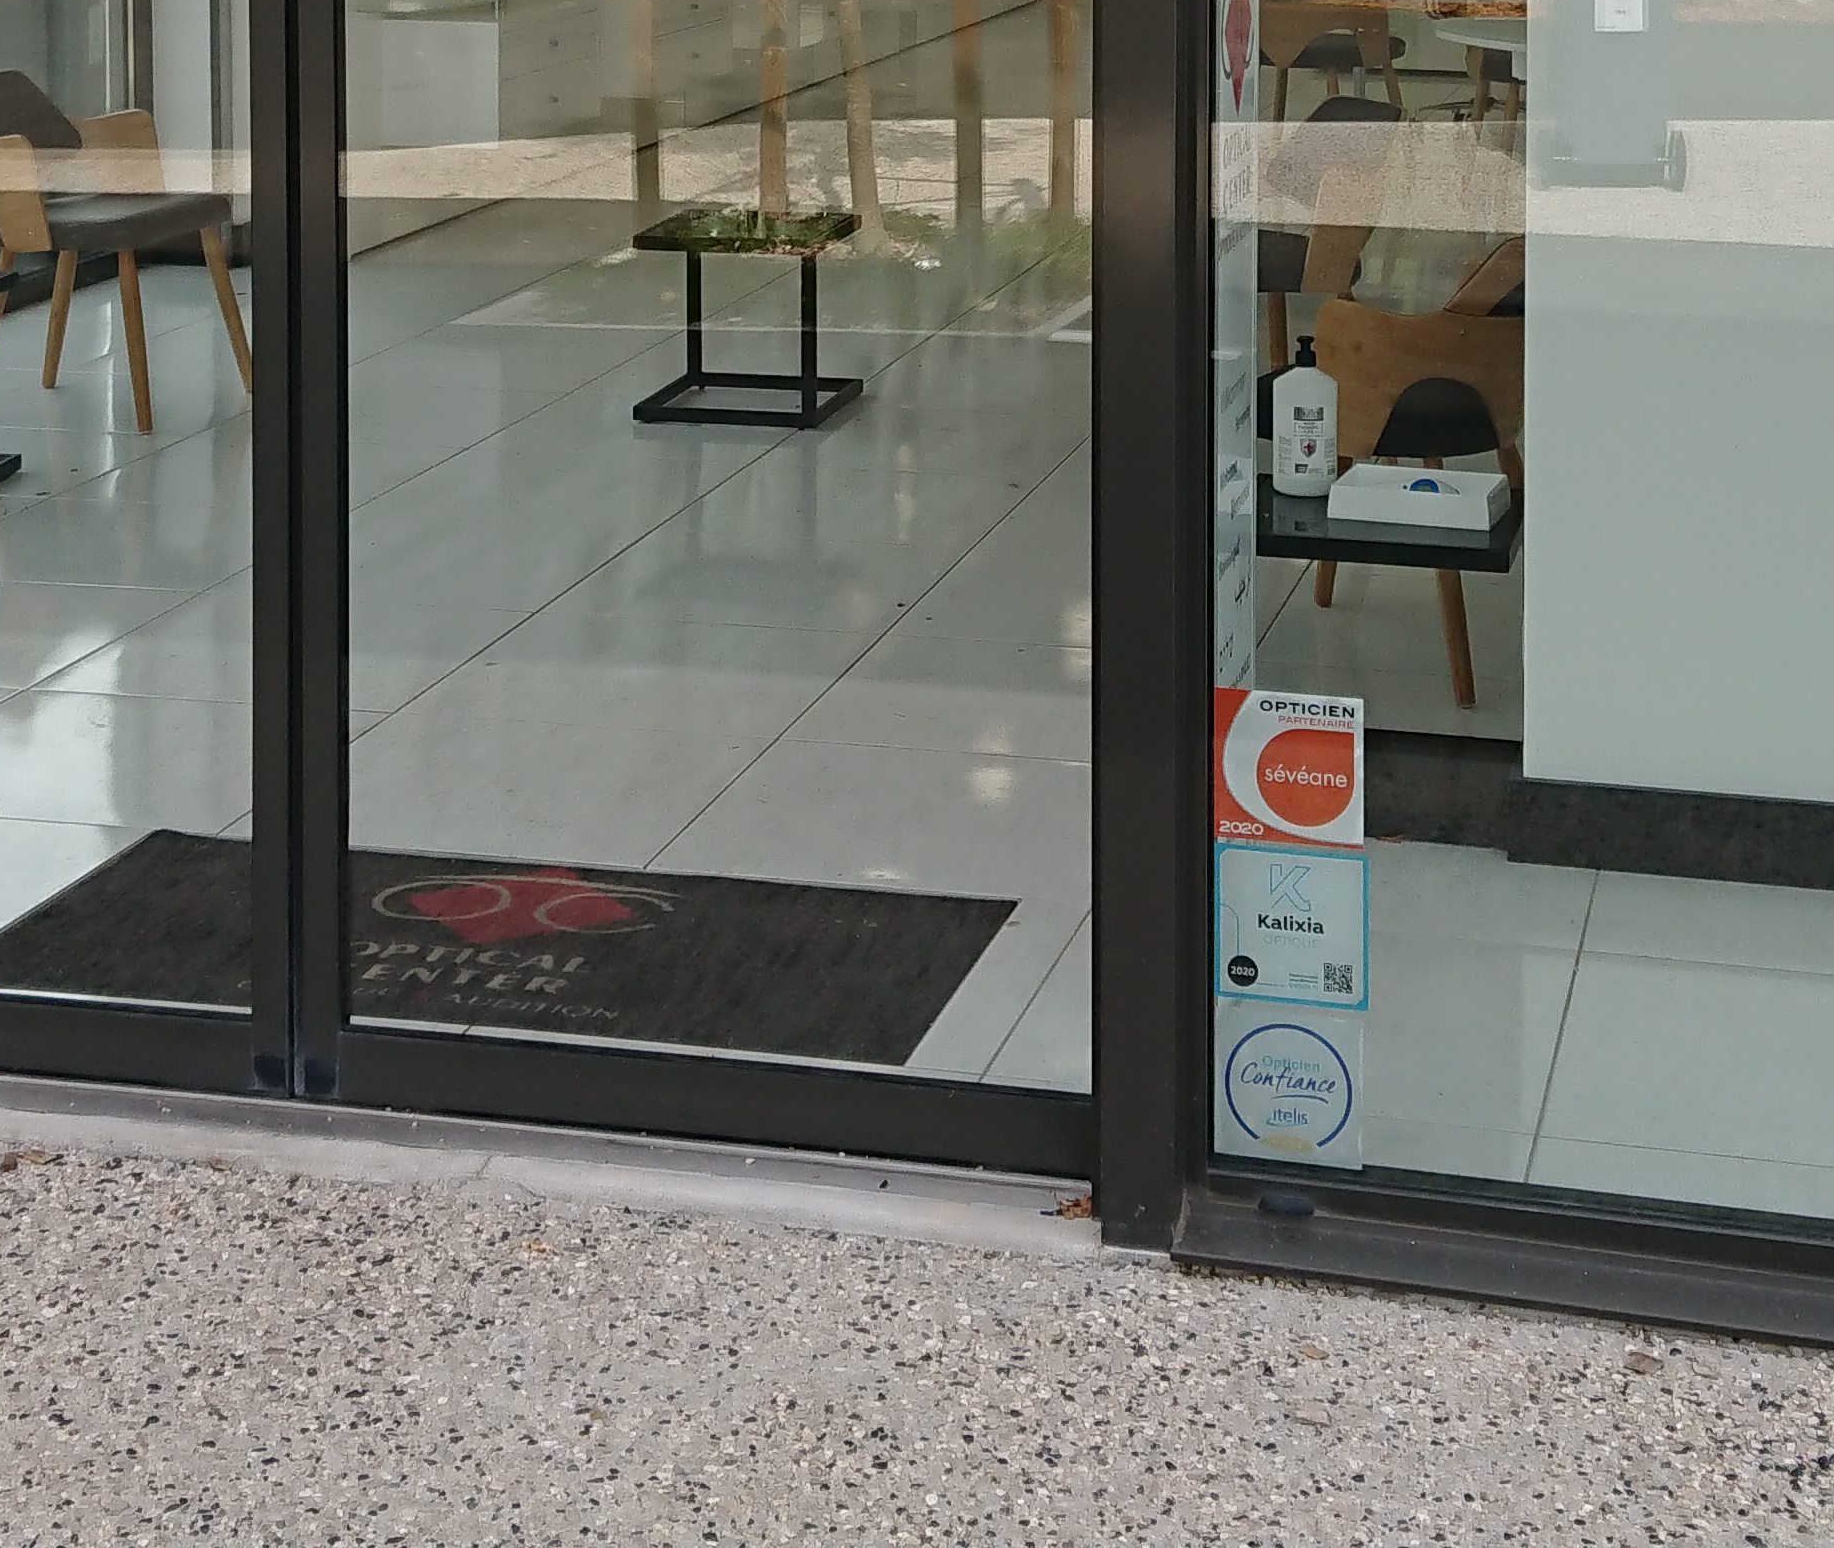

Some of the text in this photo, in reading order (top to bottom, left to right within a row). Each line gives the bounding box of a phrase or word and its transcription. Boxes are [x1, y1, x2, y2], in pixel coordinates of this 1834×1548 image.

[1260, 700, 1355, 719] OPTICIEN
[1278, 716, 1354, 729] PARTENAIRE
[1264, 764, 1348, 788] sévéane
[1219, 820, 1264, 835] 2020
[1257, 913, 1325, 934] Kalixia
[350, 963, 569, 994] ENTER
[1230, 965, 1255, 977] 2020
[1262, 1055, 1321, 1072] Opticien
[1240, 1062, 1337, 1094] Confiance
